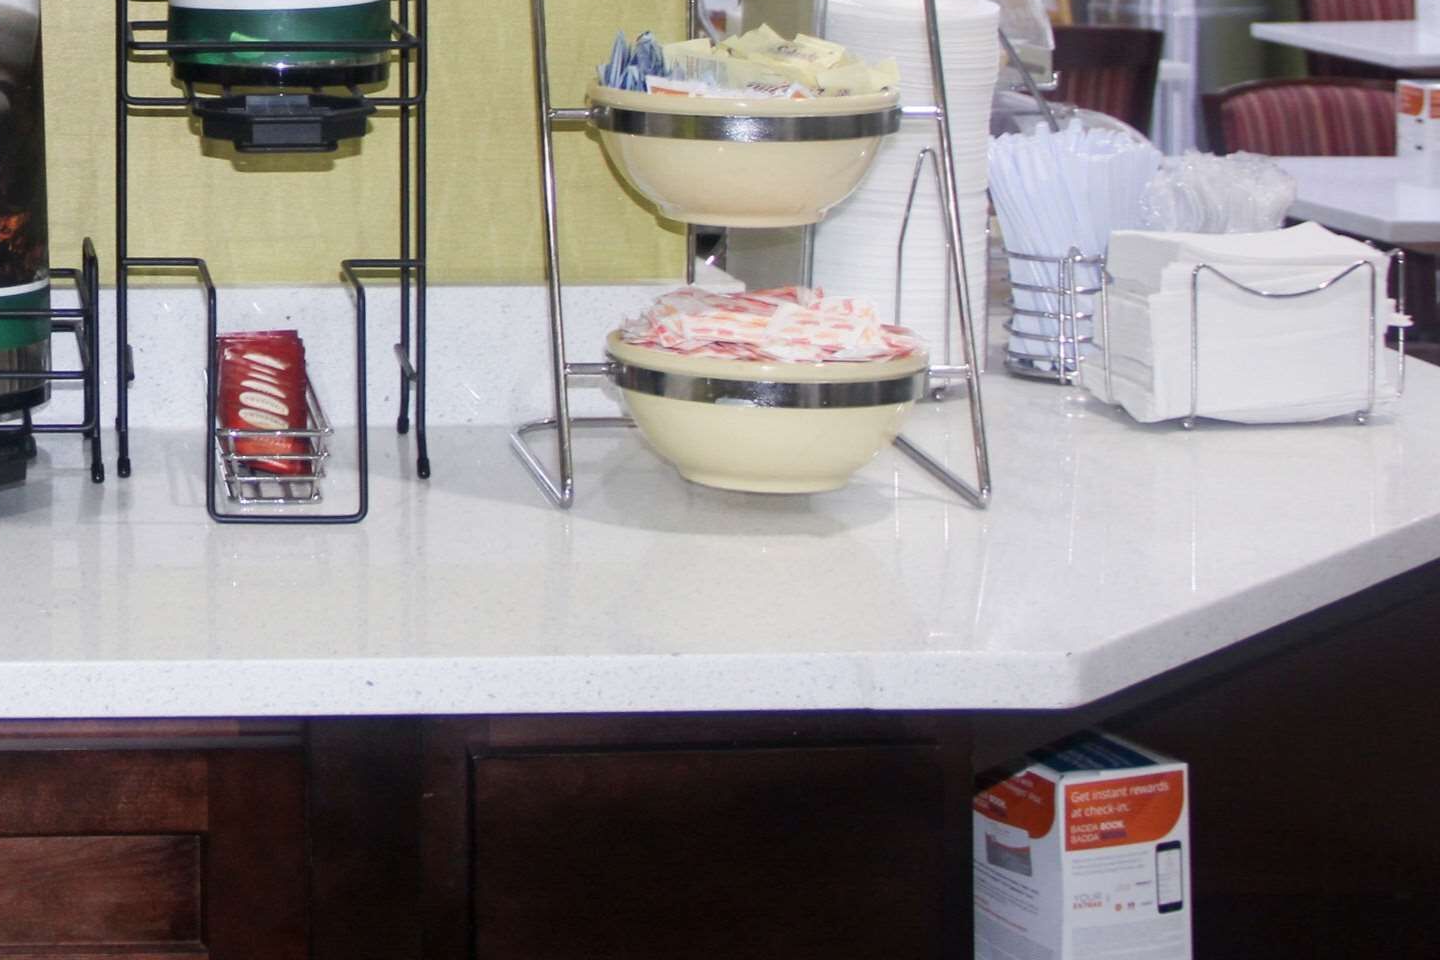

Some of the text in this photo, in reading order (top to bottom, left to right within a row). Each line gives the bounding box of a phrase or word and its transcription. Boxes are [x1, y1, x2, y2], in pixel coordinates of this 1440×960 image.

[1071, 781, 1169, 803] Get instant rewards
[1071, 807, 1083, 818] at
